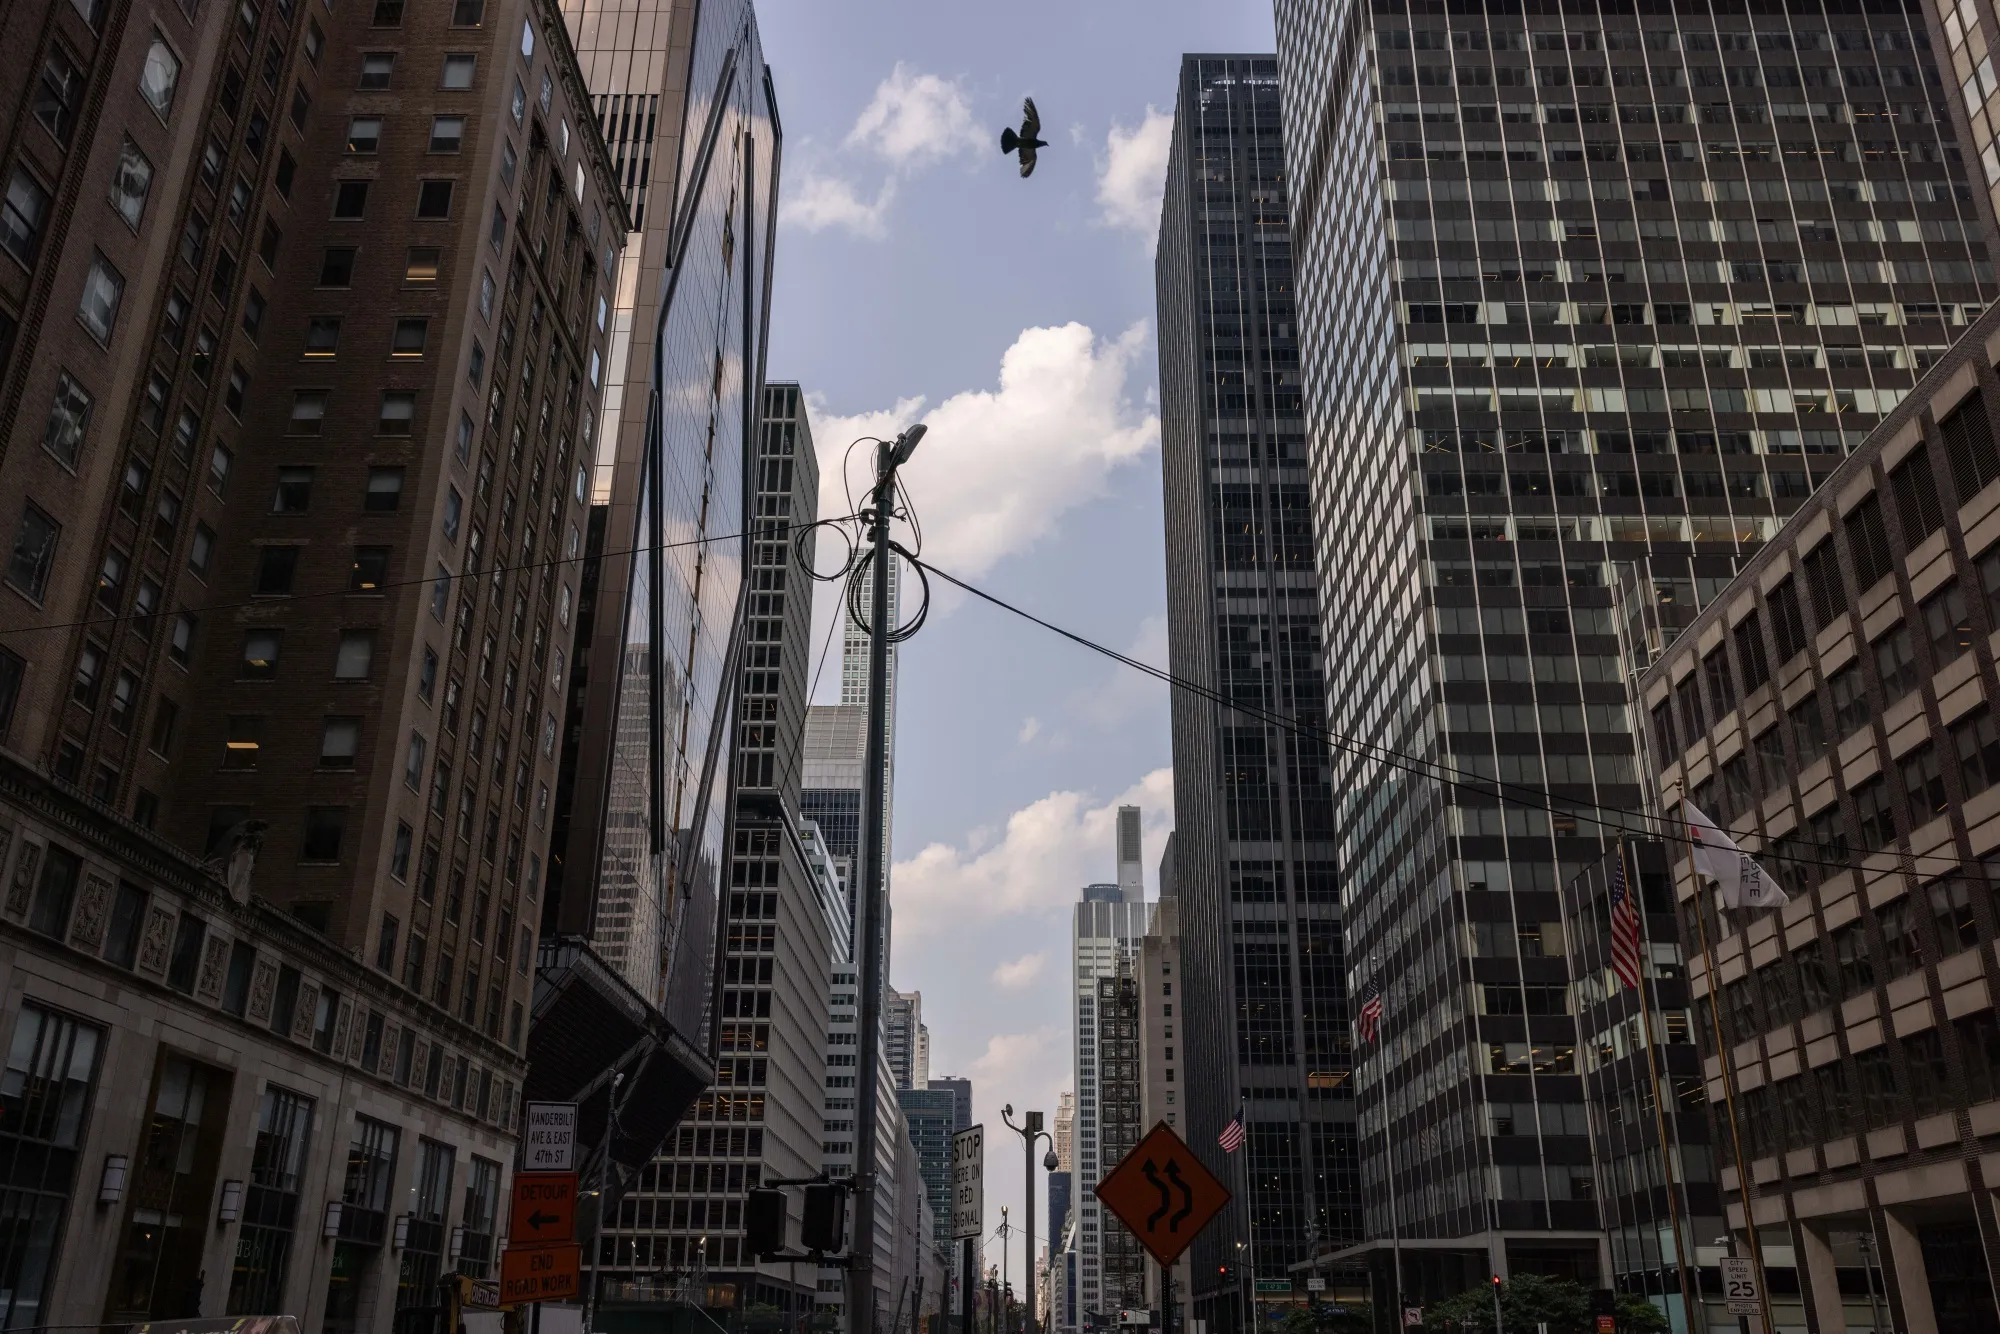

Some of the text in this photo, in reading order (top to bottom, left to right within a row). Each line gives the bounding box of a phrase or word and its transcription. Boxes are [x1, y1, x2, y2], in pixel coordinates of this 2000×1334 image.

[531, 1112, 573, 1126] VANDERBILT
[530, 1131, 571, 1144] AVE & EAST
[535, 1150, 564, 1163] 47th ST
[954, 1134, 981, 1163] STOP
[953, 1162, 980, 1185] HERE ON
[520, 1184, 568, 1201] DETOUR
[959, 1186, 973, 1205] RED
[953, 1208, 979, 1229] SIGNAL
[530, 1254, 554, 1272] END
[506, 1274, 572, 1294] ROAD WORK
[1728, 1281, 1755, 1297] 25
